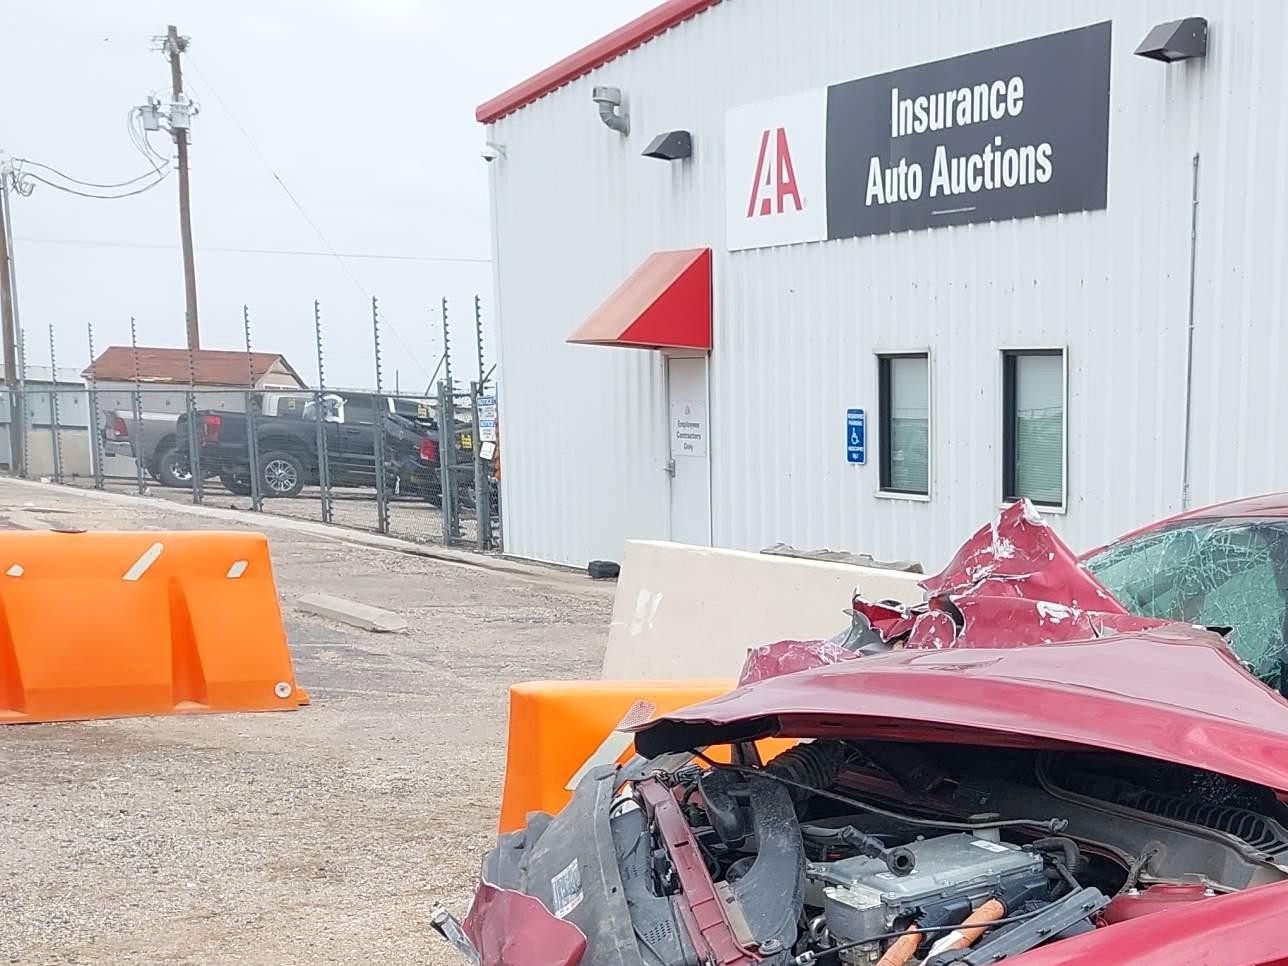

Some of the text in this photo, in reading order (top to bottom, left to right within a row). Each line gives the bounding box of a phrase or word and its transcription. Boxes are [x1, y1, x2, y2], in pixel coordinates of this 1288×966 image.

[891, 76, 1024, 138] Insurance
[865, 135, 1053, 206] Auto Auctions
